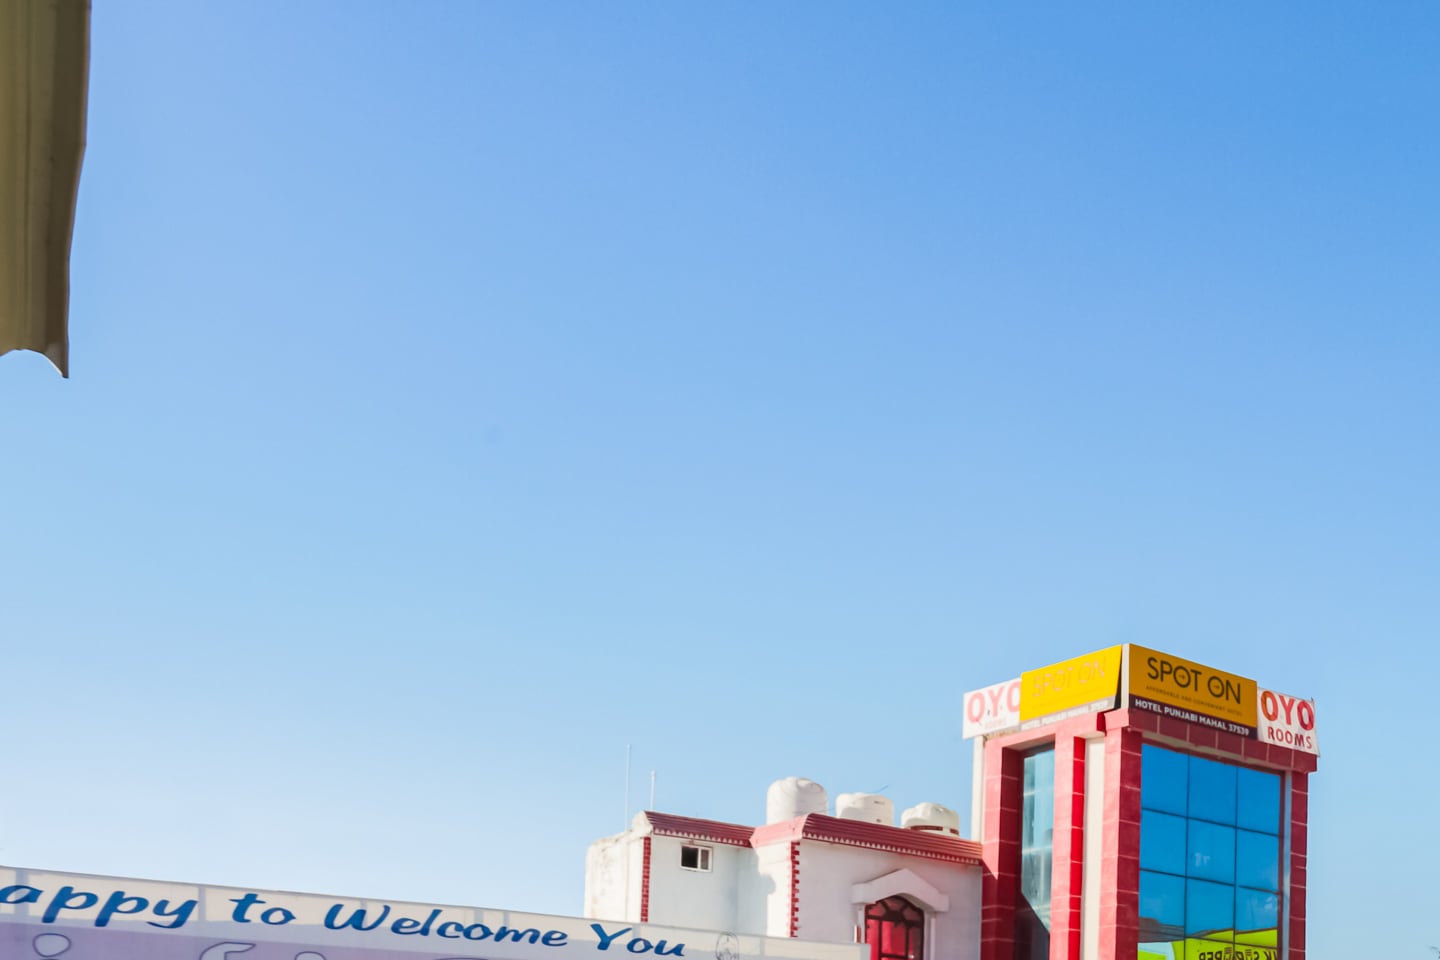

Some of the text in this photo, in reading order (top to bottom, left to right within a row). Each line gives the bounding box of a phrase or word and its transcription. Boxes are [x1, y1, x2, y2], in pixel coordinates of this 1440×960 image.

[966, 680, 1021, 724] OYO
[1147, 656, 1241, 706] SPOT ON
[1135, 699, 1162, 714] HOTEL
[1164, 706, 1198, 722] PUNJABI
[1199, 716, 1228, 731] MAHAL
[1261, 690, 1315, 731] OYO
[1267, 727, 1313, 750] ROOMS
[229, 893, 296, 925] to
[323, 904, 568, 948] Welcome
[591, 923, 686, 958] You
